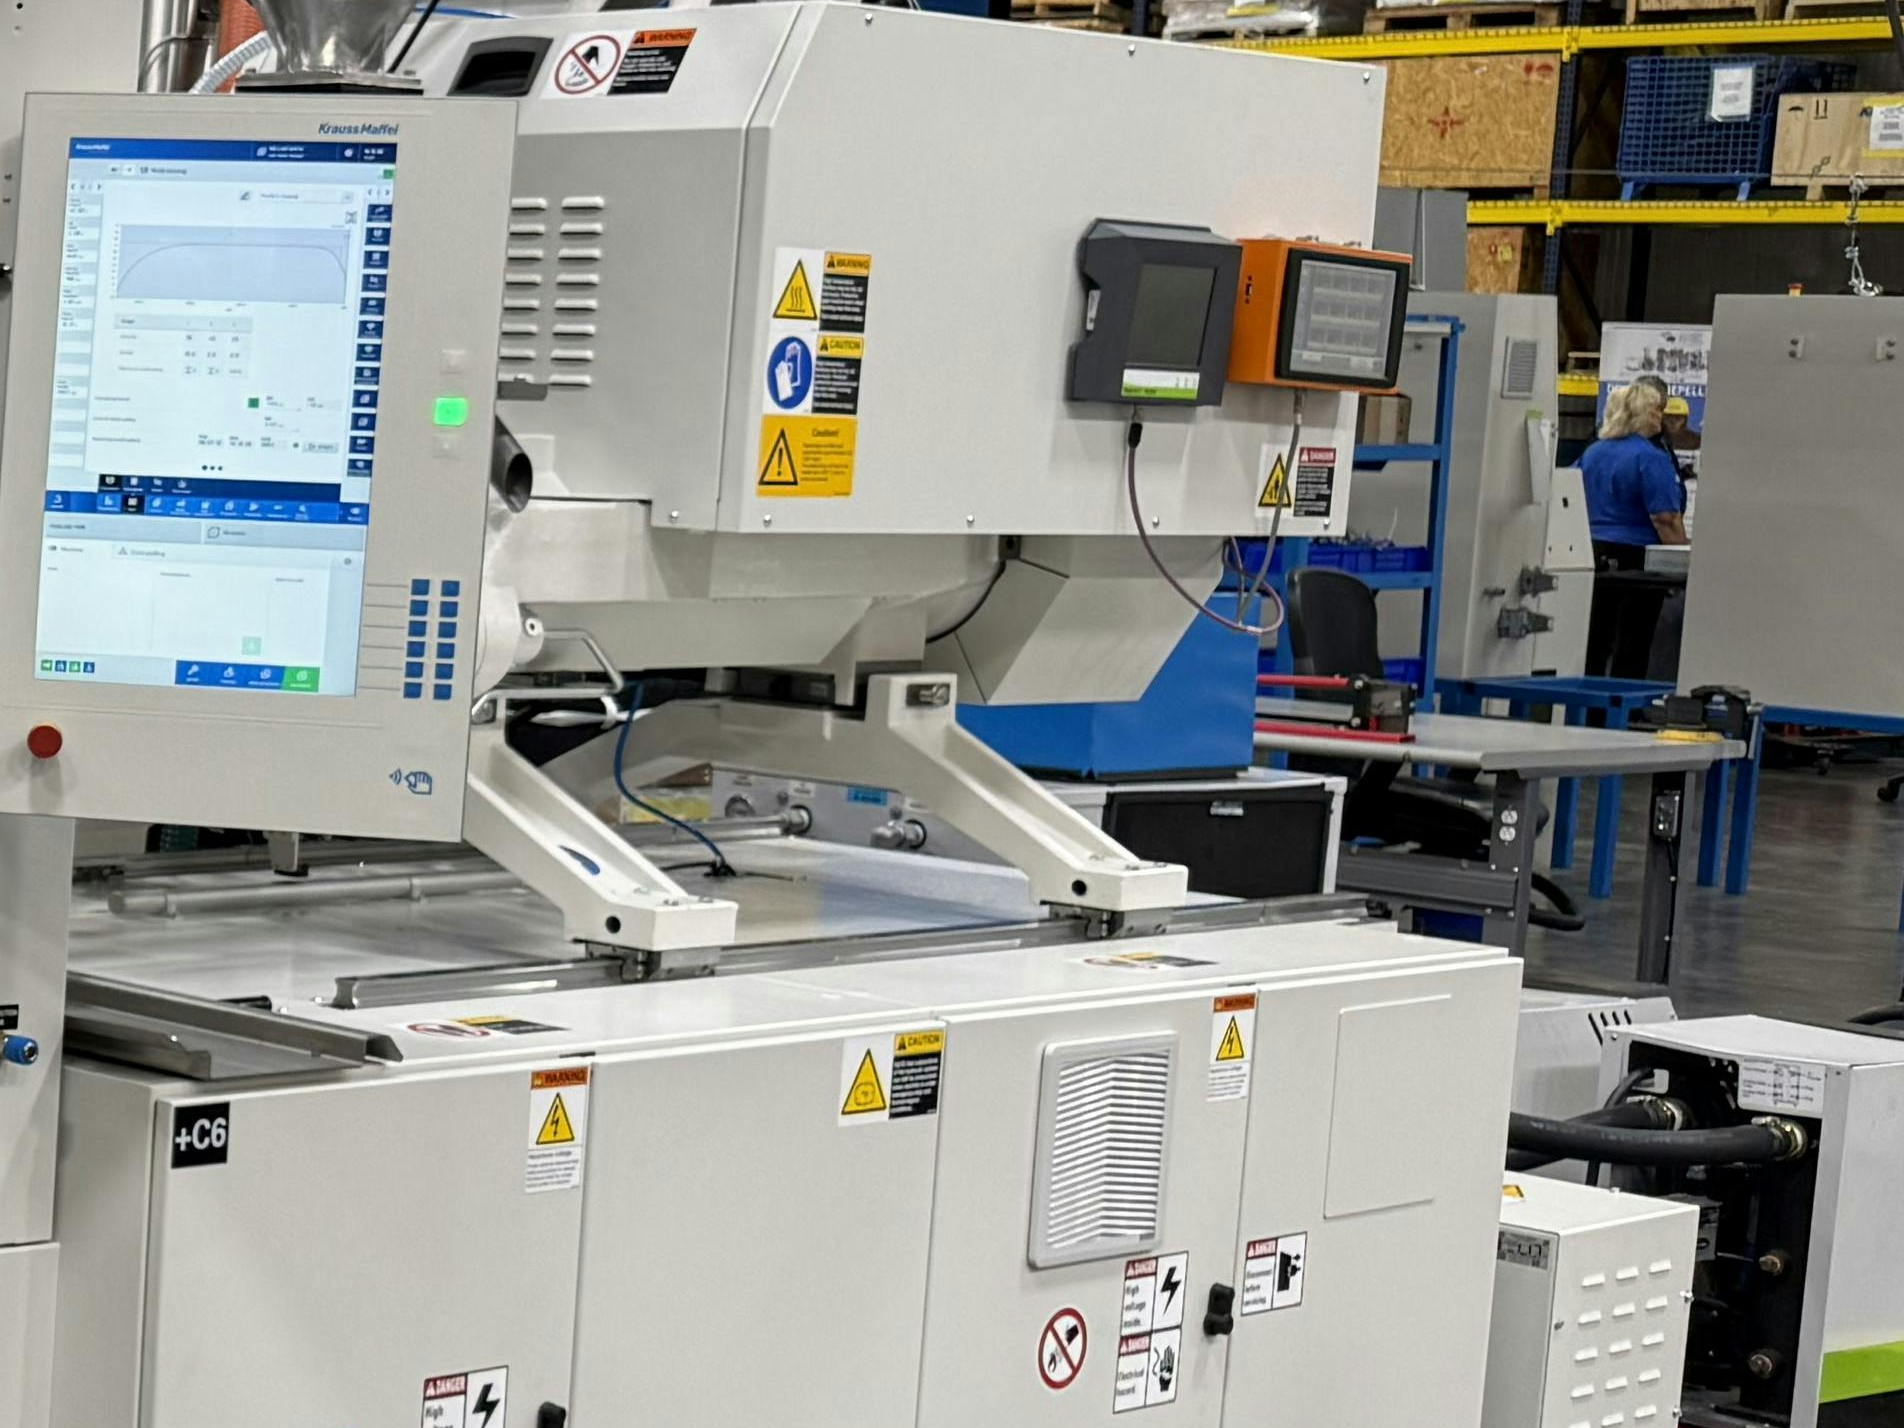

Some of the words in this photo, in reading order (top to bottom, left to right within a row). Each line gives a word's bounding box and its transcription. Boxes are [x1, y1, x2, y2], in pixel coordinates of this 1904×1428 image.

[836, 258, 868, 268] WARNING
[830, 341, 860, 350] CAUTION
[908, 1035, 940, 1045] CAUTION
[175, 1117, 226, 1151] +C6
[436, 1377, 466, 1395] DANGER
[426, 1406, 443, 1420] High
